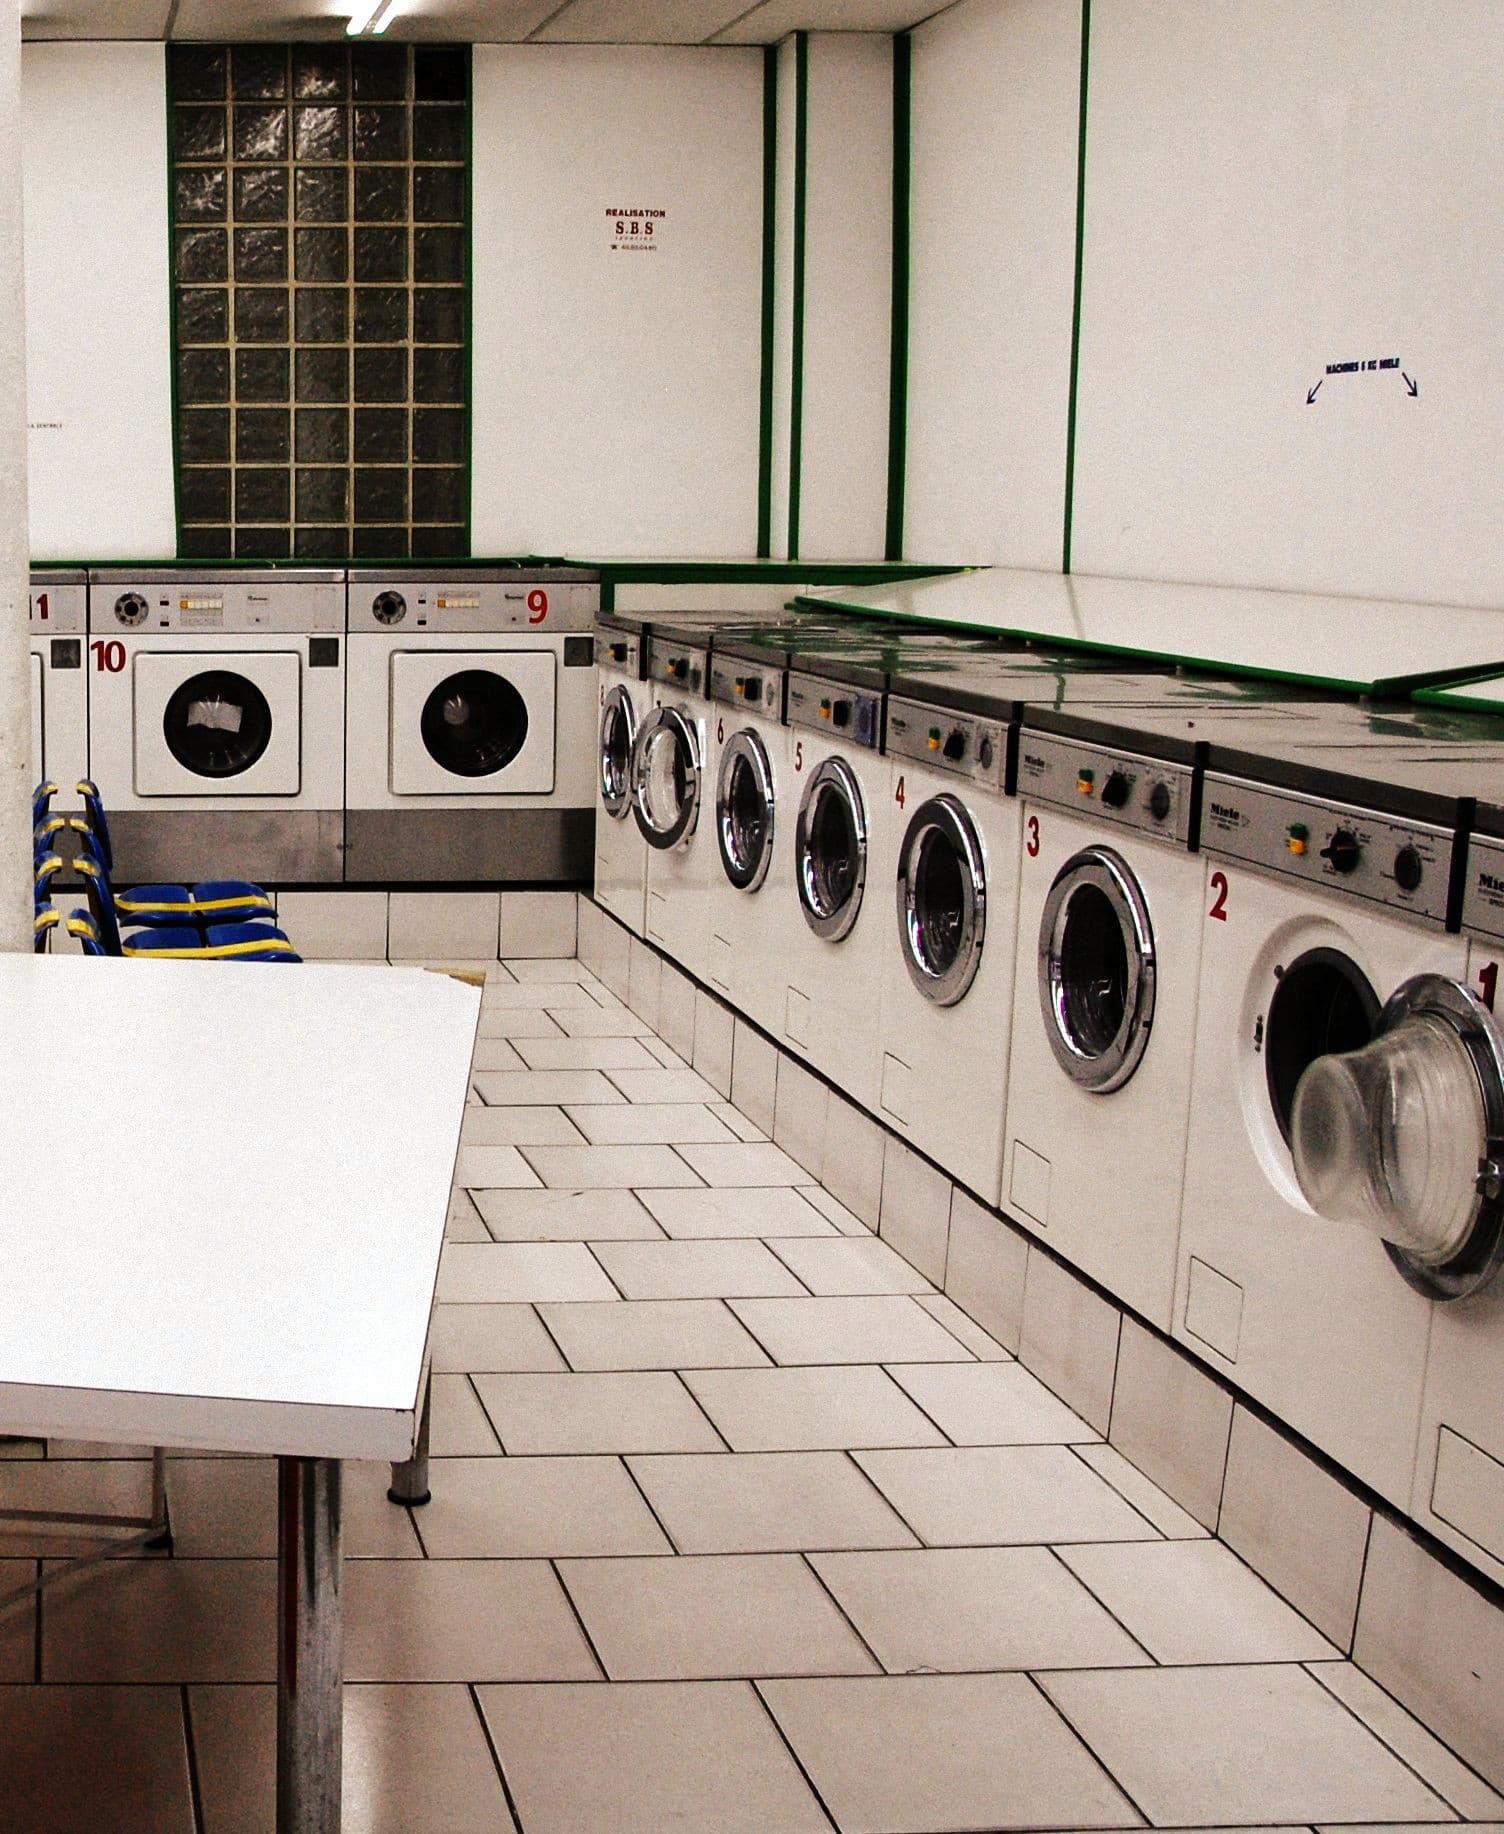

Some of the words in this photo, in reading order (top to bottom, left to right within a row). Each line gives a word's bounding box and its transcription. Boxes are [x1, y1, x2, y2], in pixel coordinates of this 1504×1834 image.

[606, 208, 666, 218] REALISATION
[528, 590, 548, 624] 9
[90, 640, 126, 673] 10
[718, 718, 724, 744] 6
[795, 742, 802, 771] 5
[896, 776, 905, 809] 4
[1210, 803, 1240, 820] Miele
[1027, 816, 1040, 857] 3
[1209, 871, 1228, 921] 2
[1479, 961, 1499, 1015] 1
